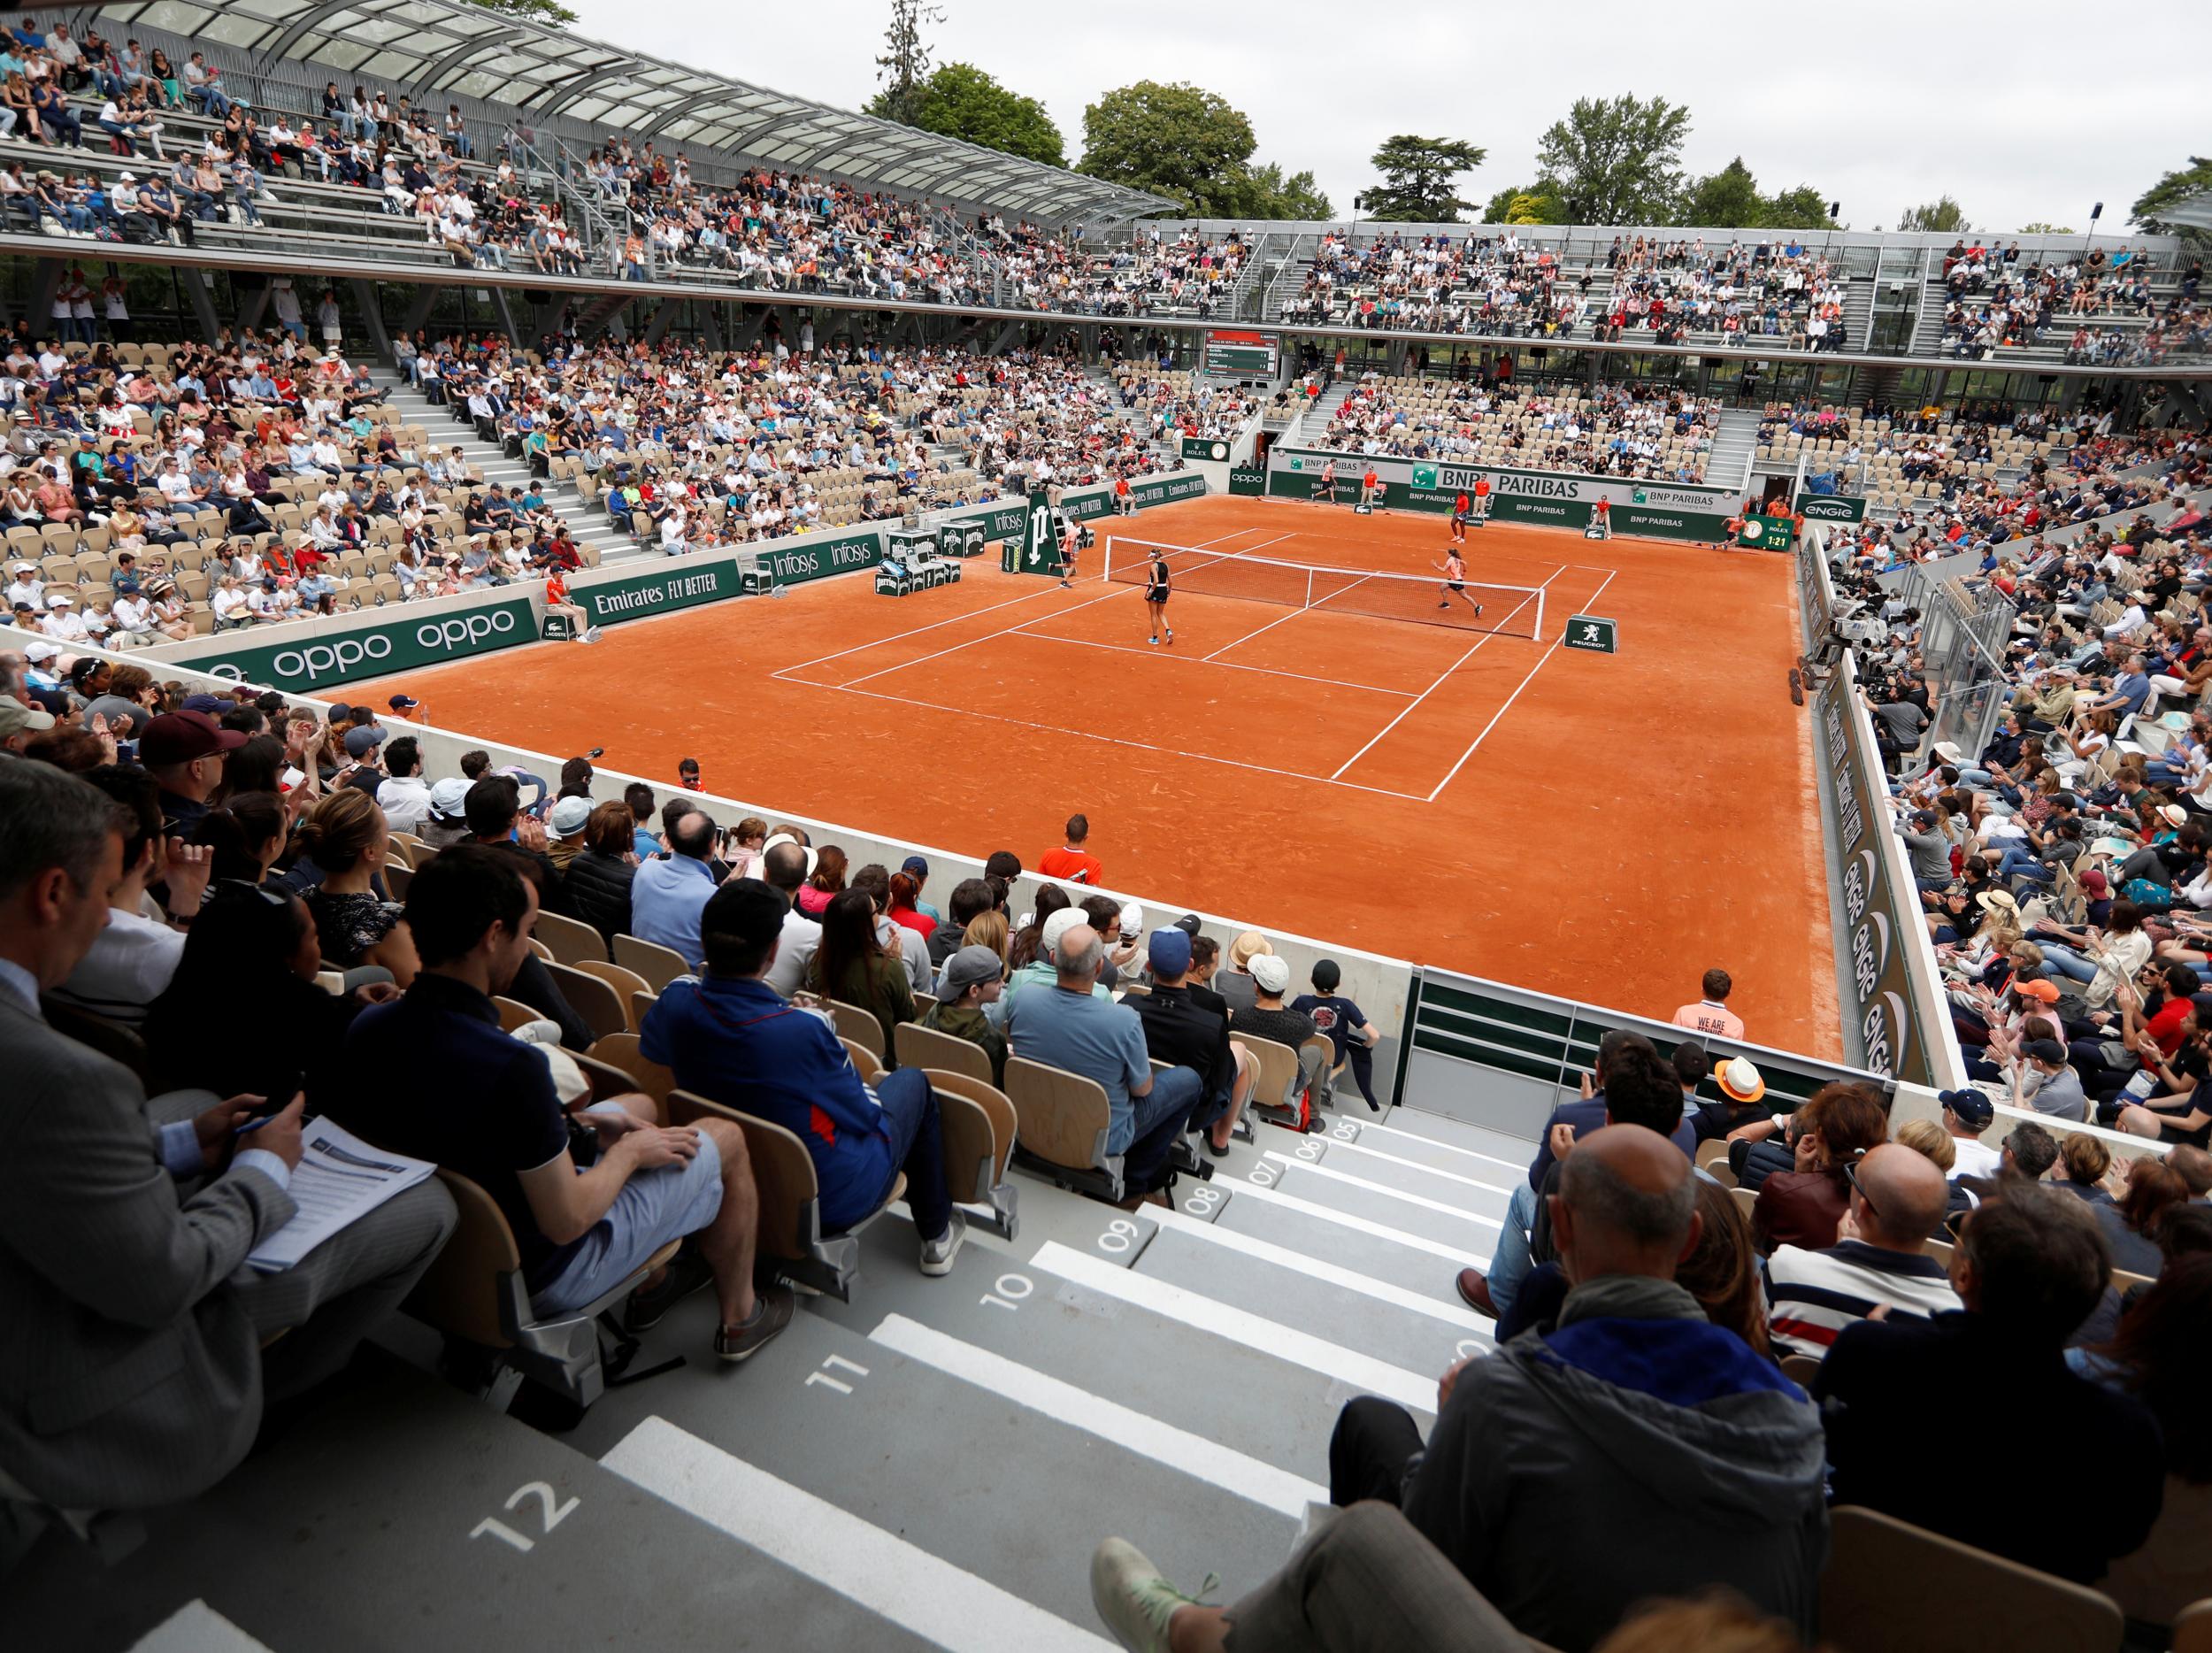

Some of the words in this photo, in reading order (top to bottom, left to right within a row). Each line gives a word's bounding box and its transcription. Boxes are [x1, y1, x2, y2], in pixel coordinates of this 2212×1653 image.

[1304, 458, 1322, 467] BNP
[1323, 460, 1357, 471] PRIBAS
[1232, 473, 1263, 484] oppo
[1442, 470, 1480, 488] BNP
[1498, 475, 1578, 498] PARIBAS
[1425, 494, 1455, 504] PARIBAS
[1649, 491, 1671, 502] BNP
[1672, 494, 1713, 505] PARIBAS
[1533, 505, 1565, 515] PARIBAS
[995, 512, 1023, 532] Infosys
[1648, 517, 1683, 527] PARIBAS
[1768, 535, 1786, 547] 1:21
[773, 552, 818, 577] Infosys
[831, 542, 871, 566] Infosys
[595, 586, 664, 615] Emirates
[667, 579, 684, 600] FLY
[684, 573, 718, 596] BETTER
[417, 610, 515, 650] oppo
[1571, 639, 1607, 649] PEUGEOT
[273, 634, 392, 680] oppo
[1699, 1016, 1709, 1027] WE
[1711, 1019, 1725, 1031] ARE
[1333, 1121, 1357, 1142] 05
[1294, 1139, 1321, 1161] 06
[1248, 1160, 1279, 1188] 07
[1185, 1187, 1221, 1215] 08
[1098, 1219, 1138, 1253] 09
[979, 1272, 1034, 1311] 10
[805, 1353, 870, 1395] 11
[469, 1480, 581, 1552] 12
